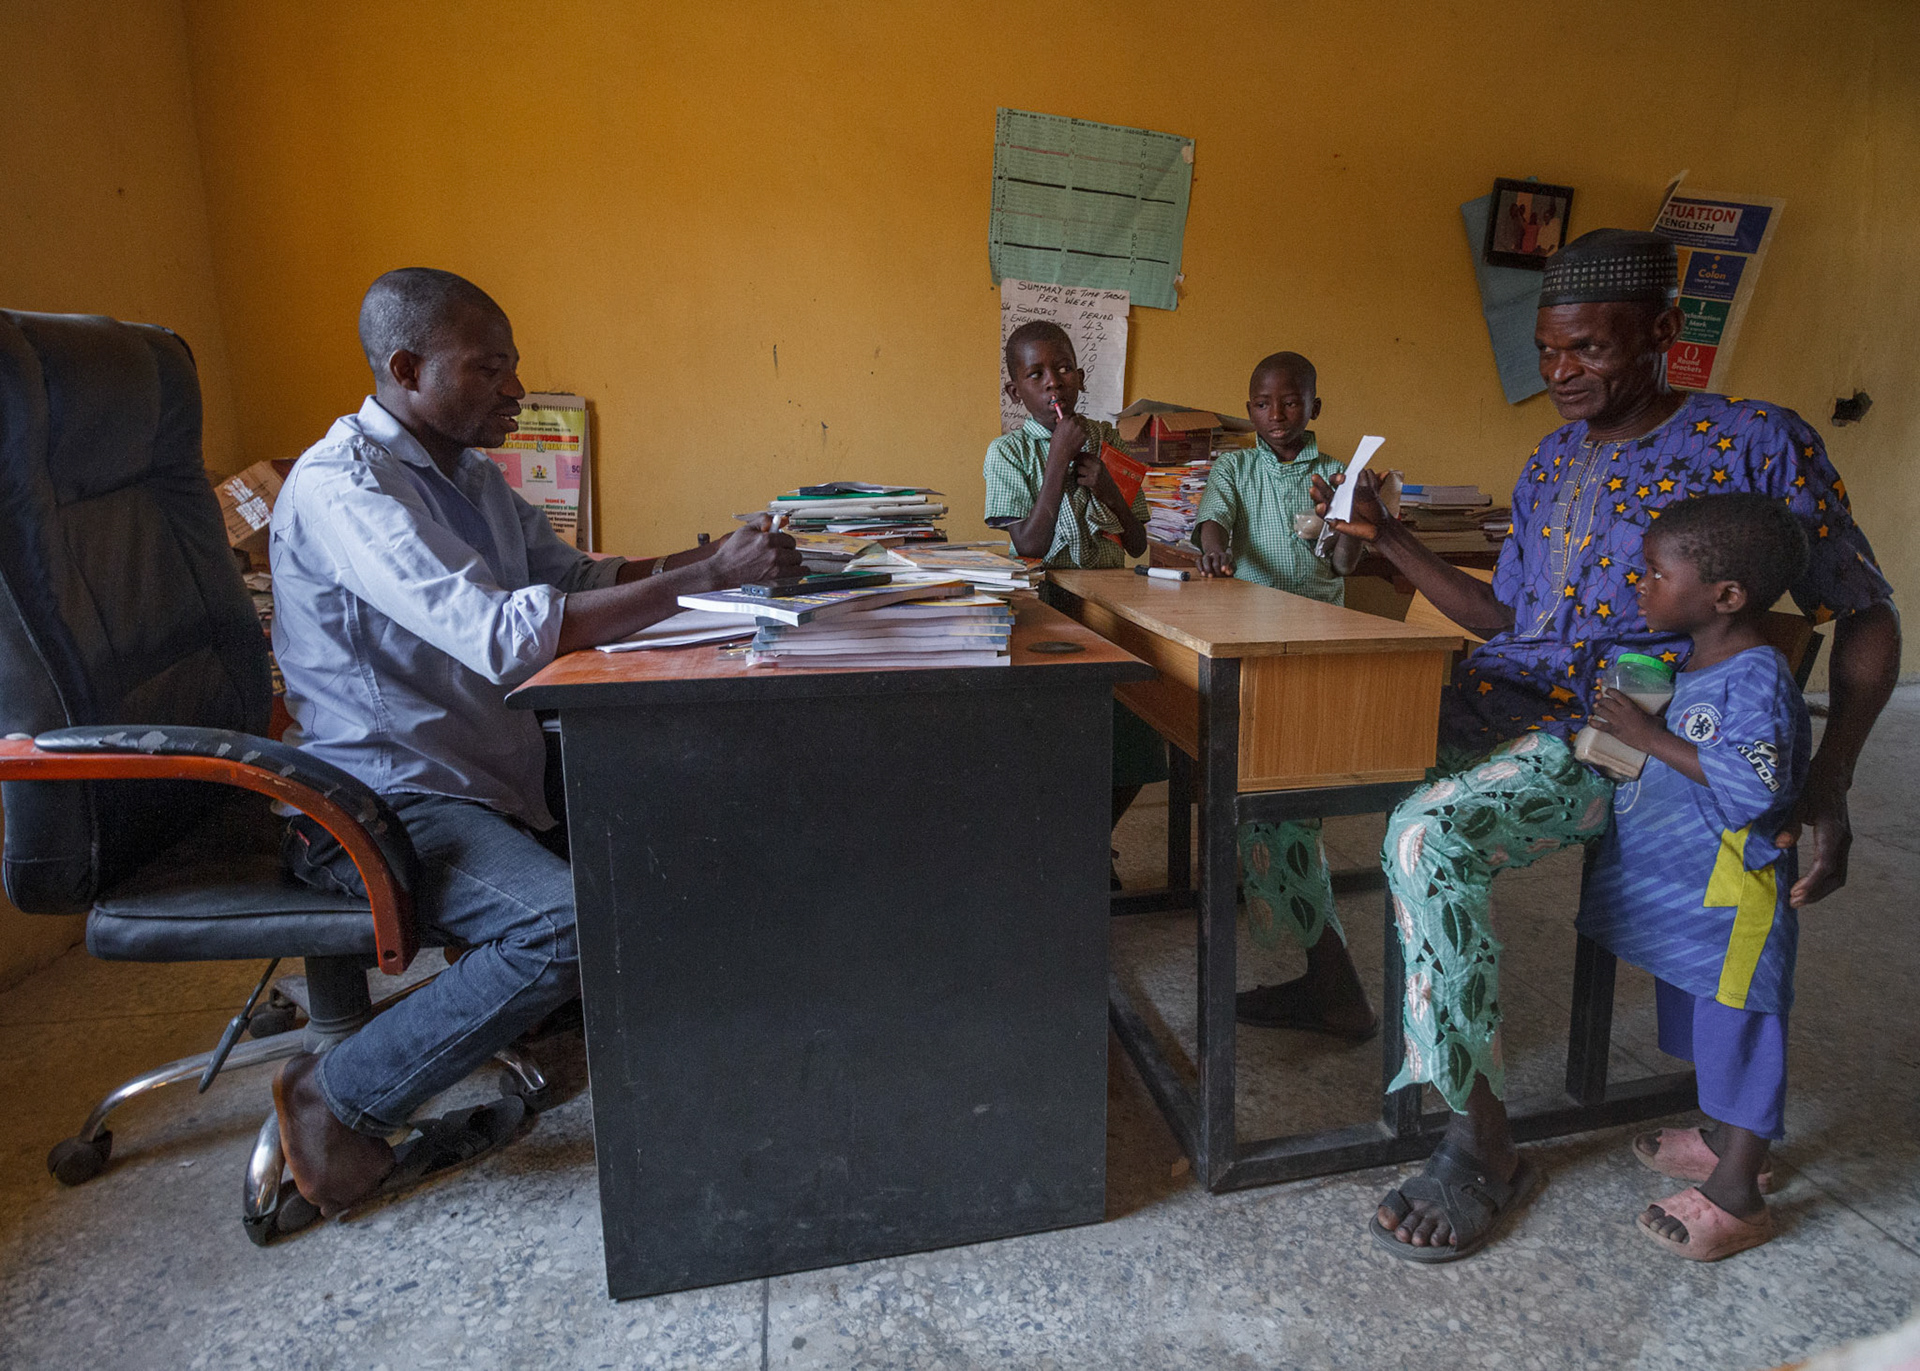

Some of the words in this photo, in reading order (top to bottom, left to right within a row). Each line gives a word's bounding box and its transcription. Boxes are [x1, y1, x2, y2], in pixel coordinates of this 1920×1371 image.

[1665, 217, 1715, 232] ENGLISH
[1698, 269, 1726, 279] Colon
[1017, 281, 1063, 294] SUMMARY
[1080, 290, 1100, 298] TIME
[1102, 291, 1126, 300] TABLE
[1037, 294, 1059, 303] PER
[1065, 297, 1096, 307] WEEK
[1016, 303, 1058, 316] SUBJECT
[1079, 310, 1114, 321] PERIOD
[1684, 312, 1721, 322] xclamation
[1083, 319, 1104, 330] 43
[1689, 319, 1707, 328] Mark
[1081, 331, 1107, 342] 44
[1081, 342, 1097, 352] 12
[1081, 353, 1097, 362] 10
[1677, 356, 1701, 366] Round
[1671, 362, 1702, 373] Brackets
[1077, 395, 1089, 404] 12
[1075, 405, 1089, 416] 12
